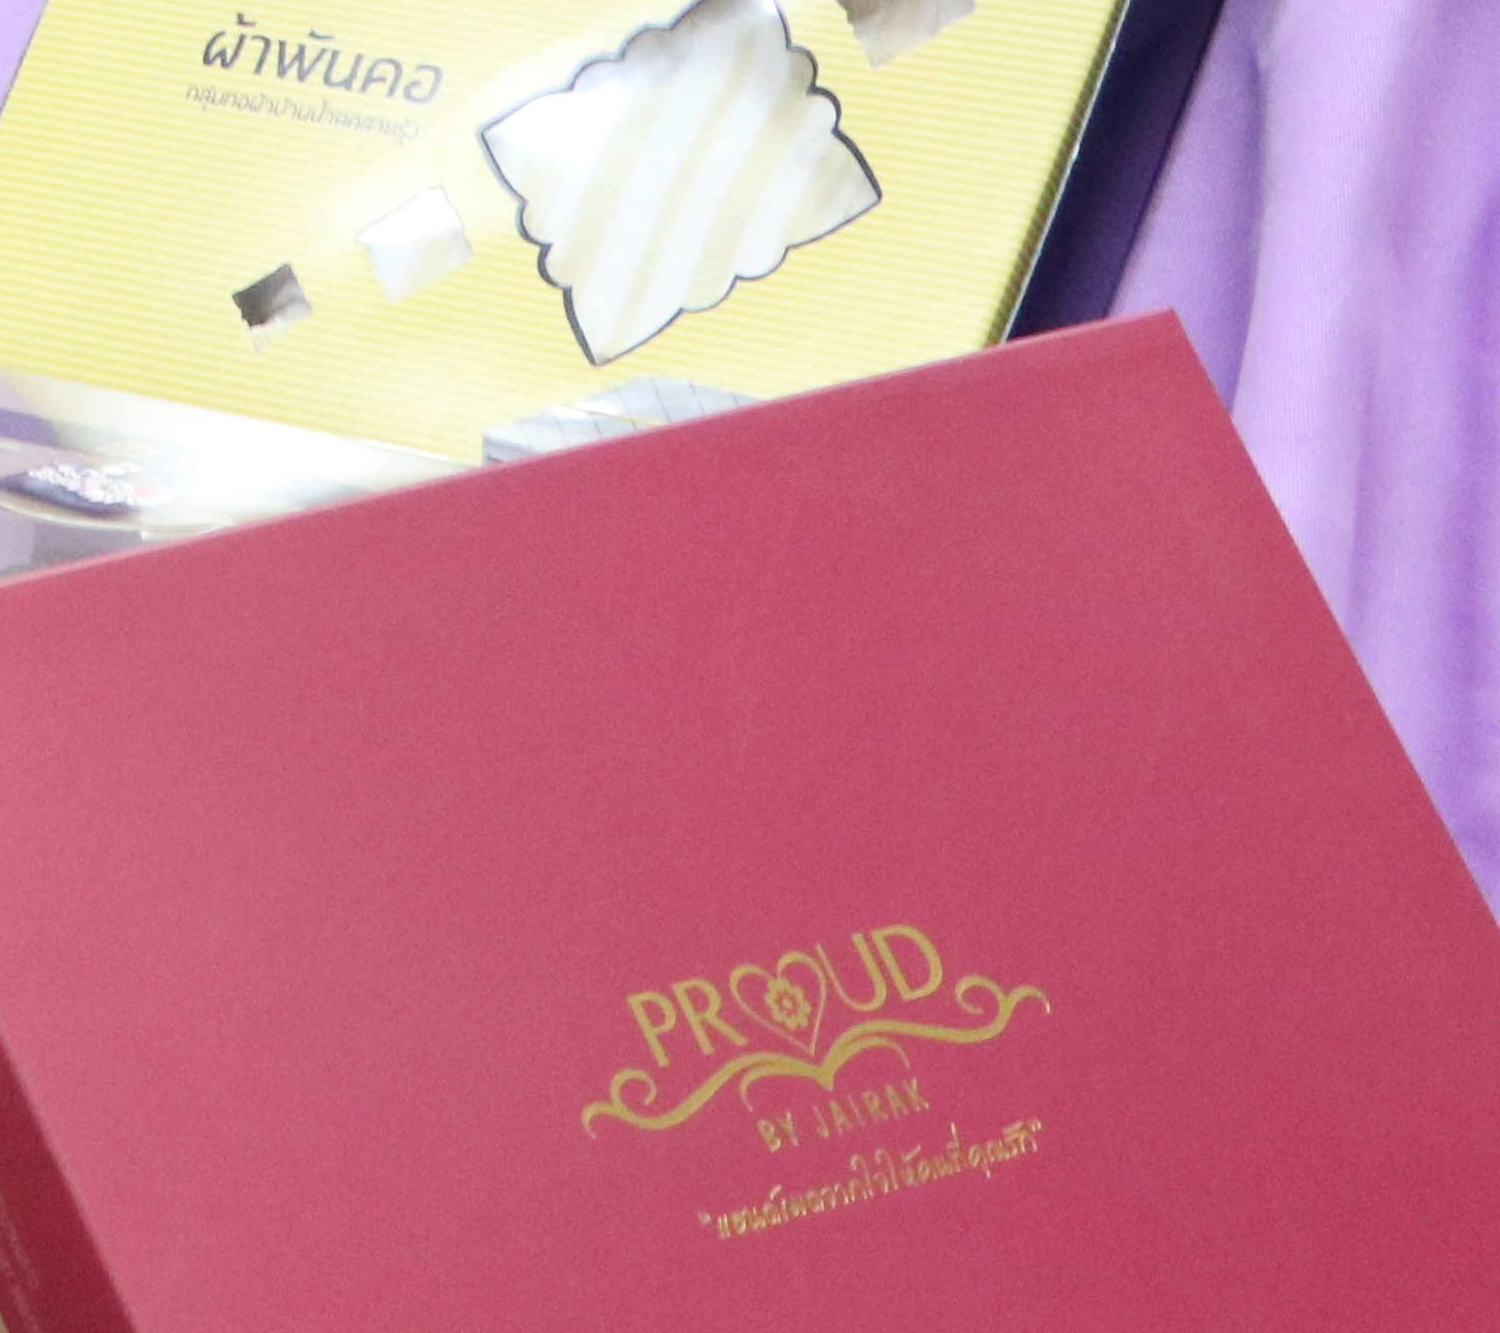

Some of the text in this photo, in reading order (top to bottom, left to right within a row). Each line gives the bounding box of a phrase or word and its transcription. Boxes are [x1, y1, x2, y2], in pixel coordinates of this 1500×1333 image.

[202, 12, 444, 105] ผ้าพันคอ
[626, 923, 944, 1069] PROUD
[756, 1077, 931, 1153] BY JAIRAK
